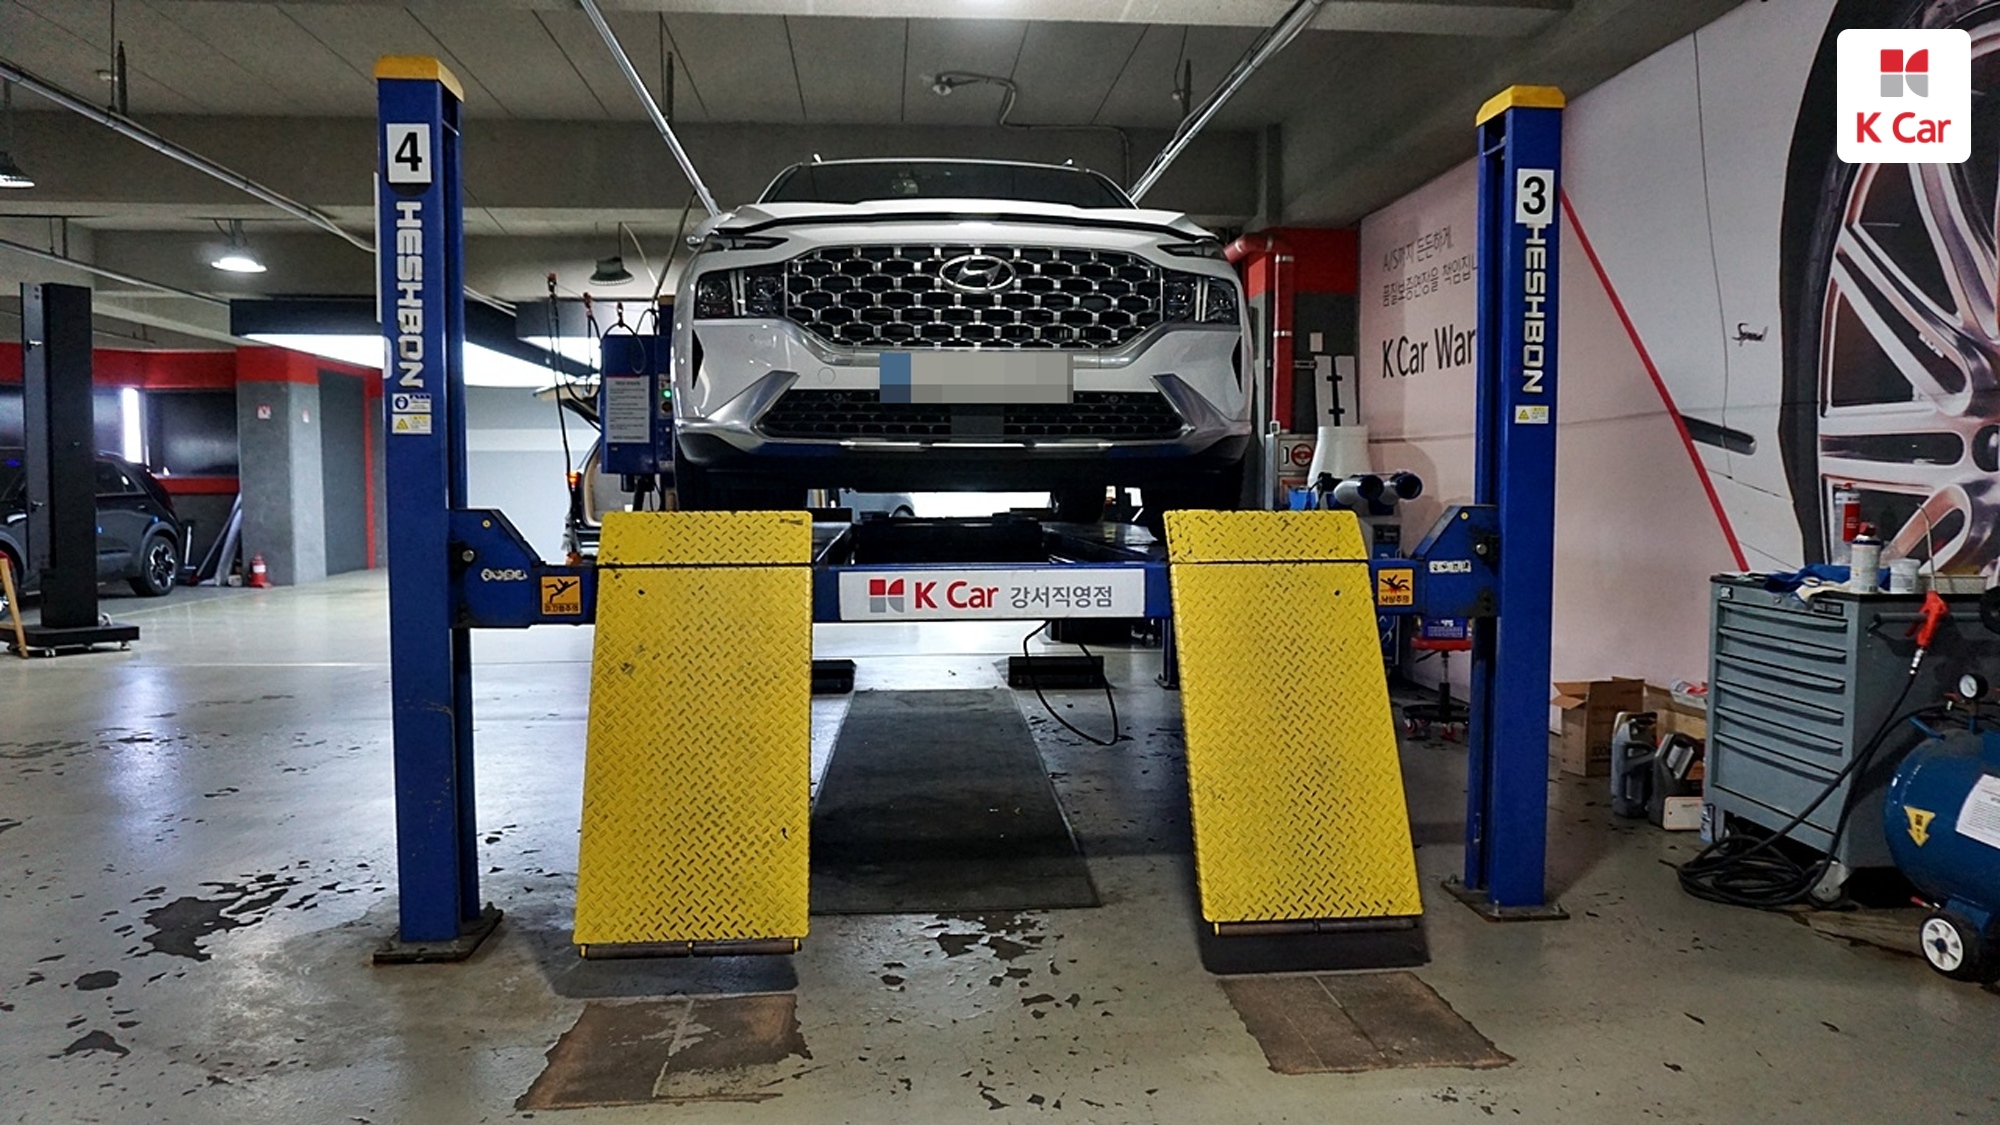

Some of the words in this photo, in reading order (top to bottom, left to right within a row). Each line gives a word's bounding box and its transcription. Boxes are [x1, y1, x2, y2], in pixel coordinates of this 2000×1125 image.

[395, 132, 422, 172] 4
[1523, 176, 1547, 215] 3
[396, 201, 424, 388] HESHBON
[1383, 267, 1439, 307] 품질보증연장을
[1522, 222, 1547, 393] HESHBON
[914, 581, 938, 609] K
[946, 581, 999, 609] Car
[1010, 586, 1113, 609] 강서직영점
